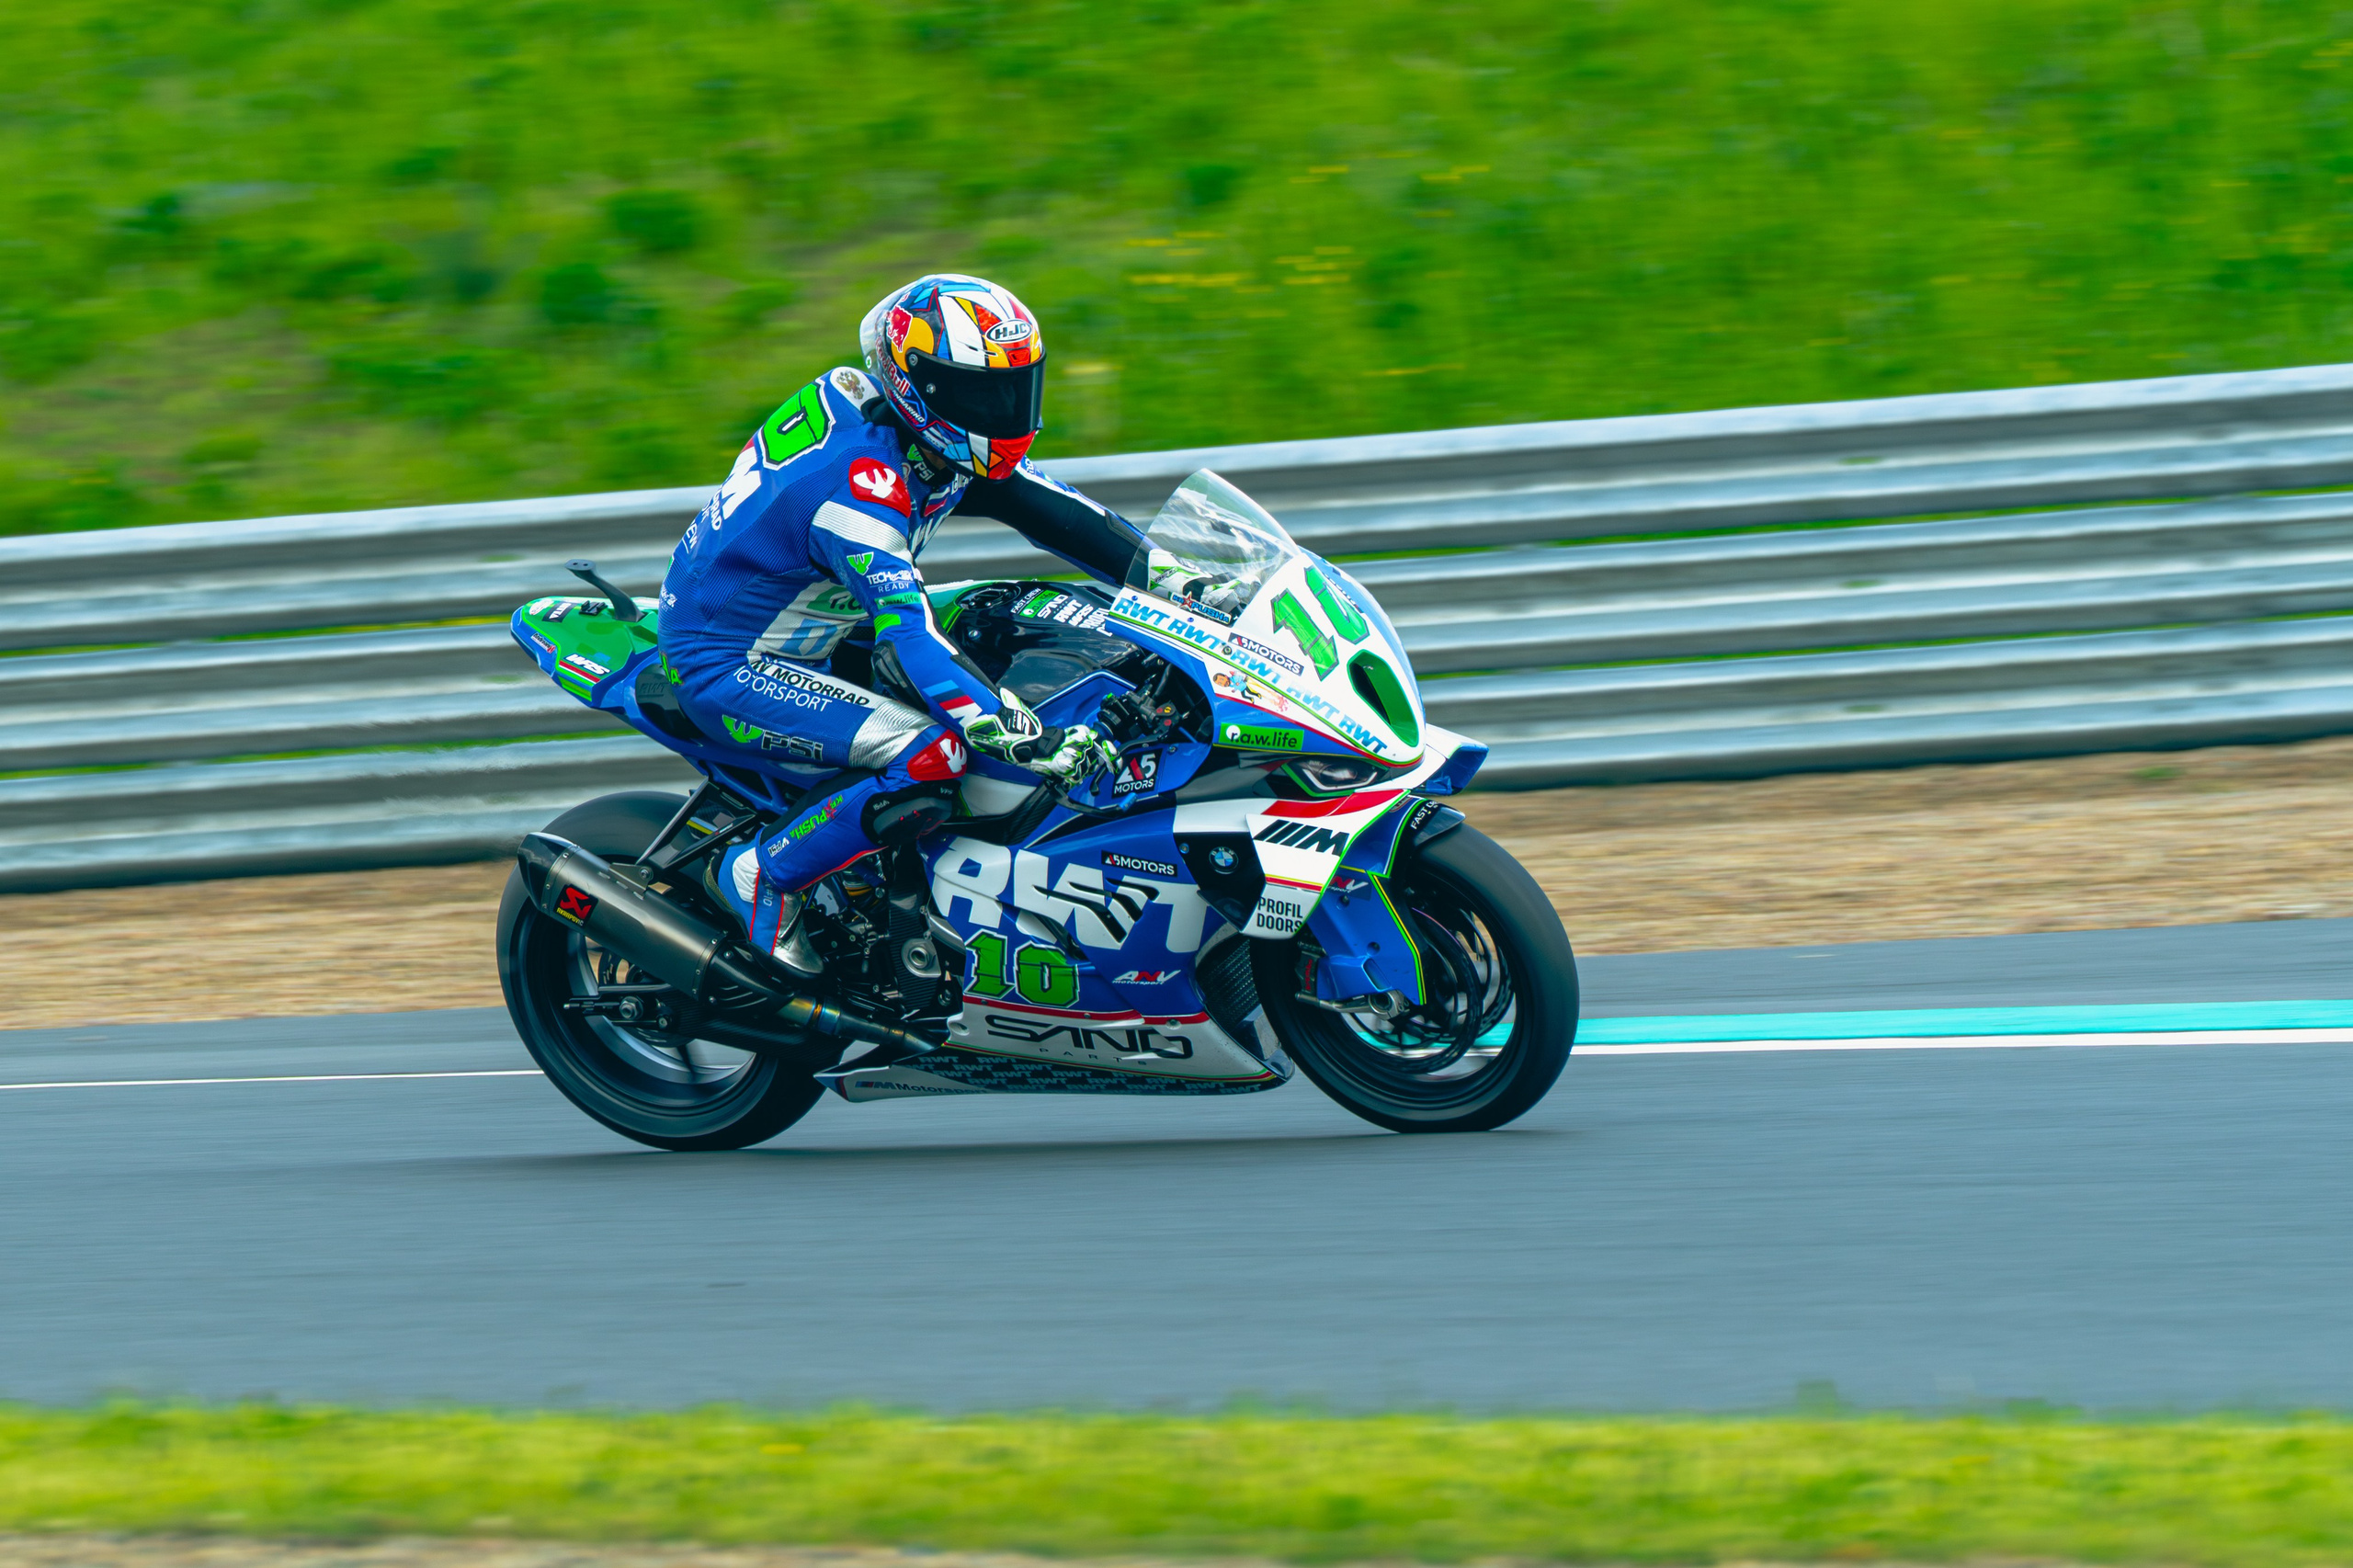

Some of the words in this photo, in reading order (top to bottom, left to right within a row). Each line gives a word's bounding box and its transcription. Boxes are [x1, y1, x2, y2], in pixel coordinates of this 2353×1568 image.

[995, 324, 1029, 340] HJC
[887, 361, 911, 397] Bull
[878, 582, 910, 593] READY
[1010, 600, 1027, 614] FAST
[1024, 587, 1041, 602] CREW
[1270, 564, 1370, 682] 10
[733, 665, 833, 712] OORSPORT
[771, 667, 870, 706] MOTORRAD
[1113, 597, 1170, 629] RWT
[1167, 619, 1223, 652] RWT
[1230, 649, 1281, 685] RWT
[1338, 716, 1388, 754] RWT
[1231, 732, 1298, 748] r.a.w.life
[1114, 779, 1154, 794] MOTORS
[1410, 807, 1428, 830] FAST
[932, 836, 1208, 954] RWT
[1257, 897, 1303, 918] PROFIL
[1256, 913, 1302, 933] DOORS
[964, 929, 1081, 1008] 10
